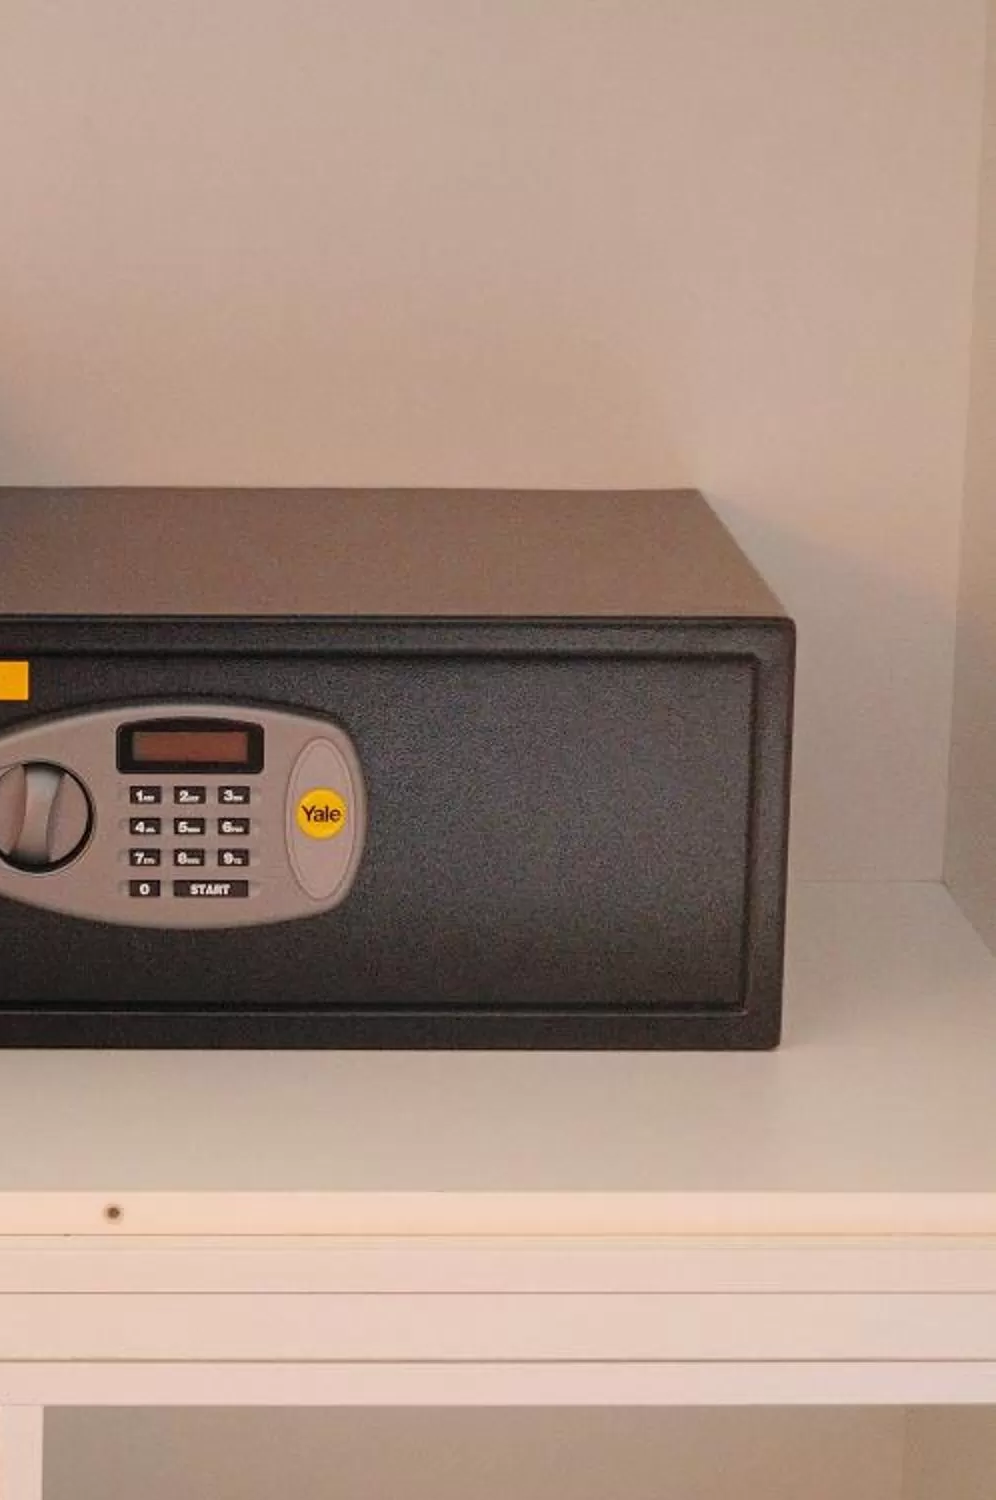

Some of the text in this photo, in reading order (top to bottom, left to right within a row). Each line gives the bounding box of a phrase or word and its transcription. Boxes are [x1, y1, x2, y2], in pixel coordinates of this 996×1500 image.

[136, 789, 143, 802] 1
[179, 789, 189, 802] 2
[223, 789, 233, 802] 3
[301, 804, 342, 823] Yale
[135, 821, 145, 833] 4
[178, 821, 188, 833] 5
[222, 821, 232, 833] 6
[134, 851, 145, 864] 7
[177, 851, 187, 864] 8
[223, 851, 234, 864] 9
[189, 883, 231, 895] START
